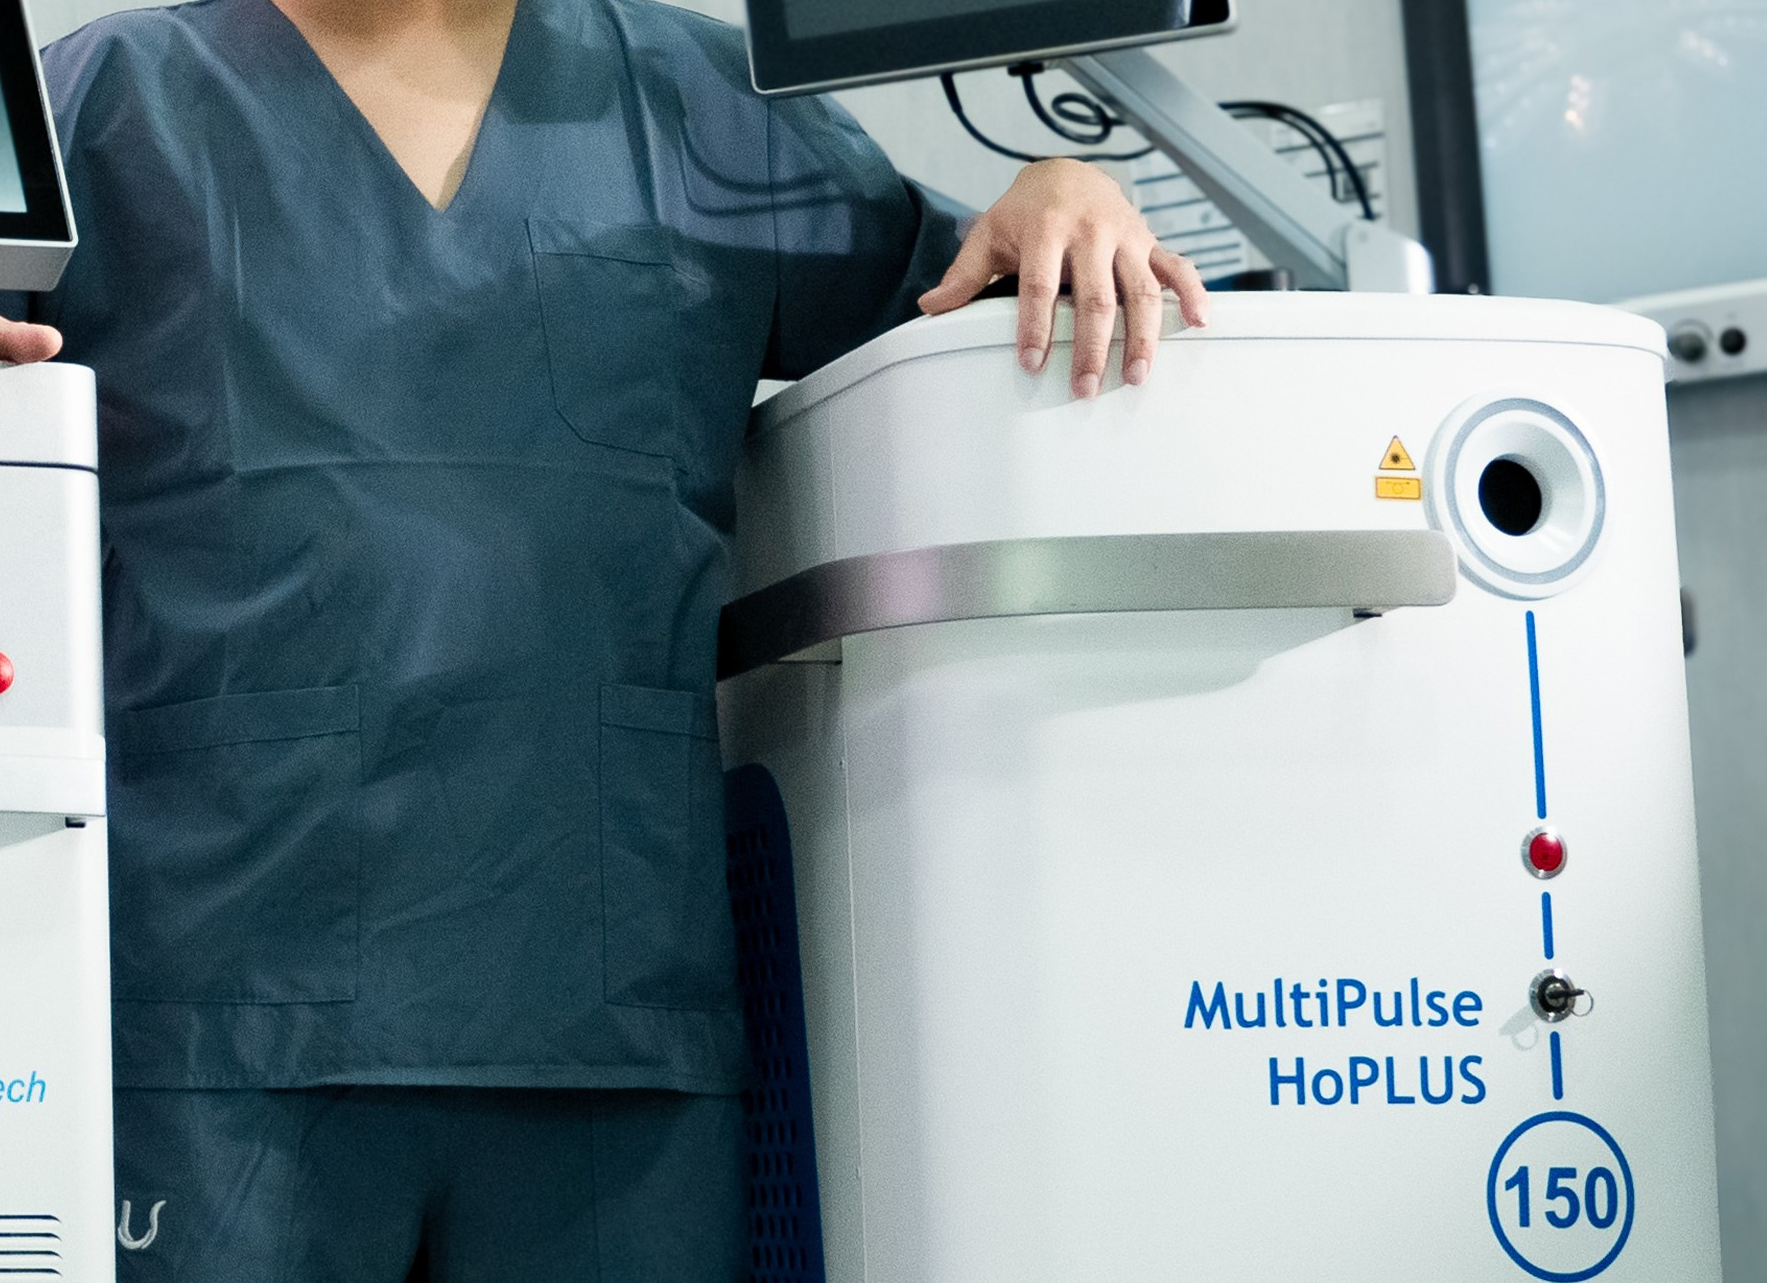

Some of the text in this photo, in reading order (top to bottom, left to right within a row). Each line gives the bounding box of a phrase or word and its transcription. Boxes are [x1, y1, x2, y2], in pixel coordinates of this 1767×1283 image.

[1183, 977, 1484, 1030] MultiPulse
[1269, 1055, 1487, 1106] HoPLUS
[1504, 1166, 1619, 1229] 150
